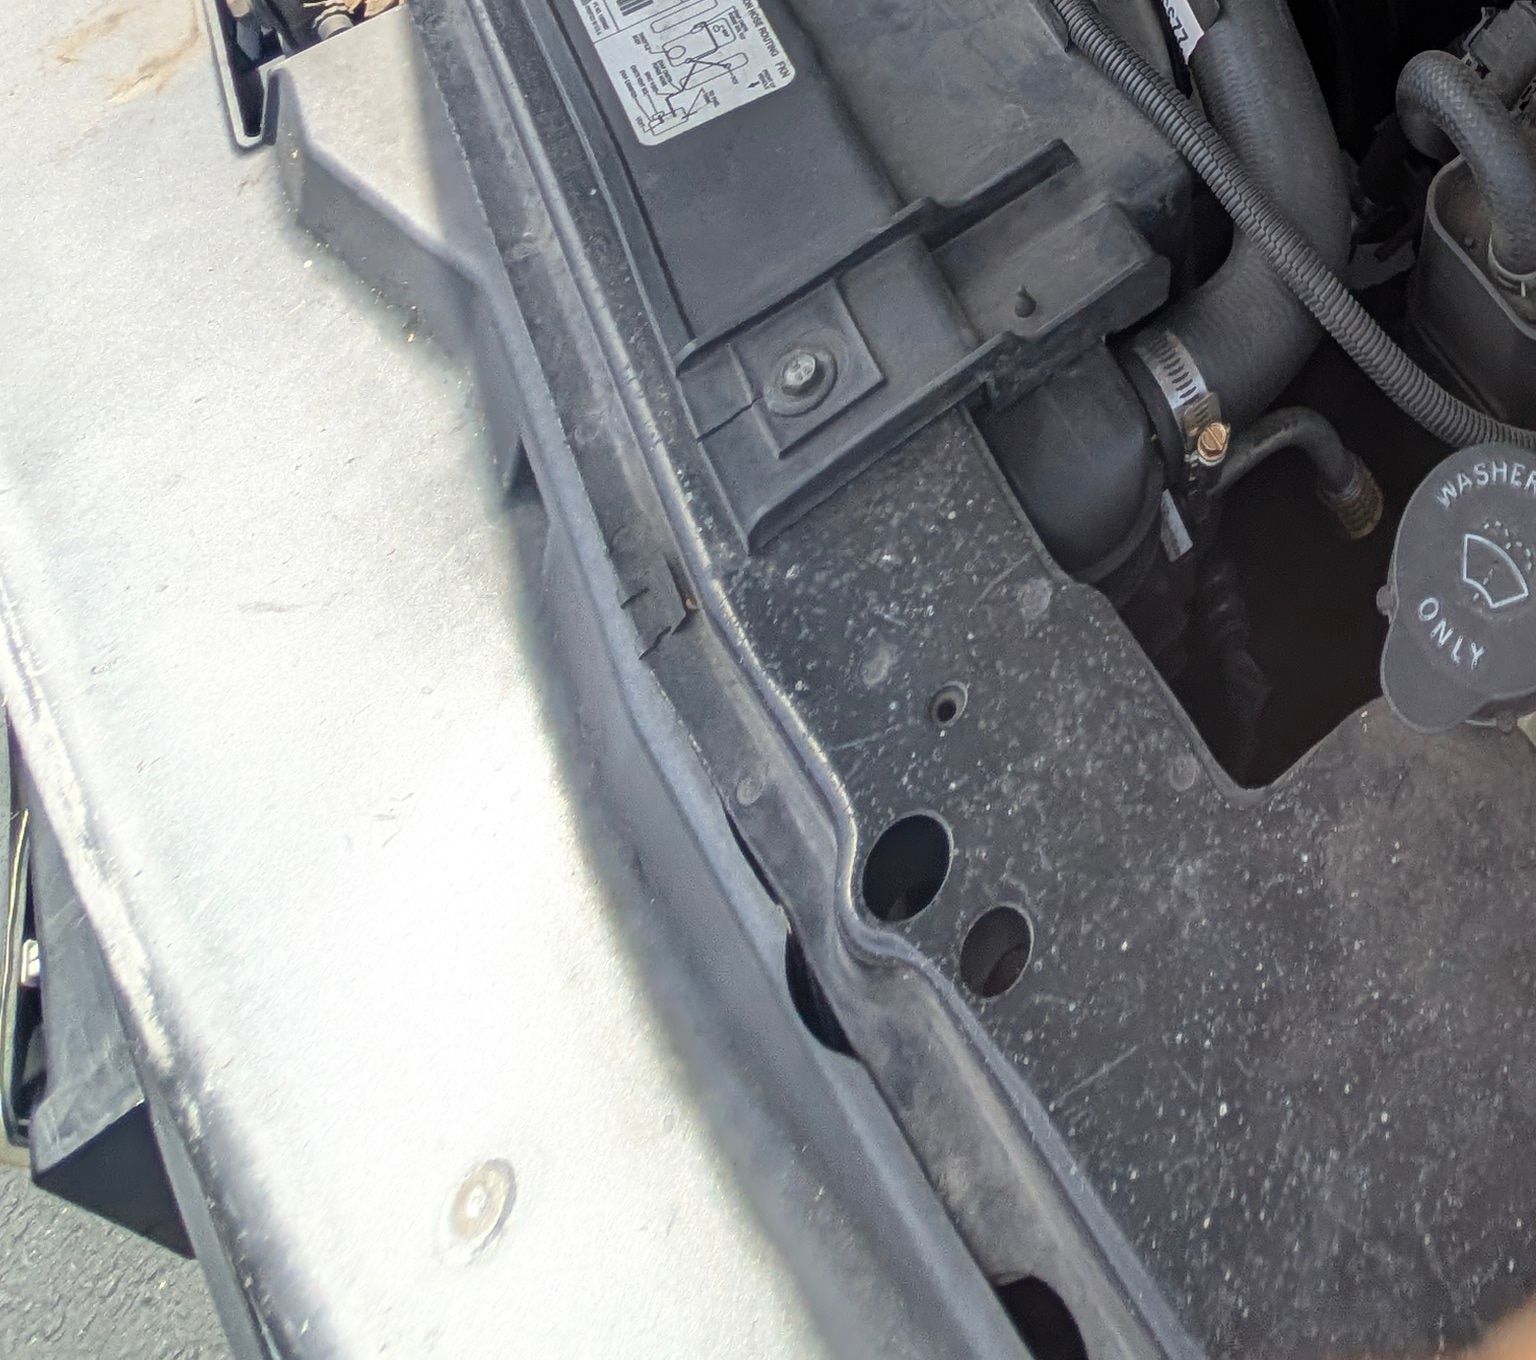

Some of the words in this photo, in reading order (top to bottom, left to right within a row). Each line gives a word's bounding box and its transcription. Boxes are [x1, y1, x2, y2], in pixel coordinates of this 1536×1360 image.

[747, 7, 763, 28] HOSE
[757, 25, 780, 57] ROUTING
[774, 60, 790, 79] FKN
[1418, 596, 1485, 670] ONLY
